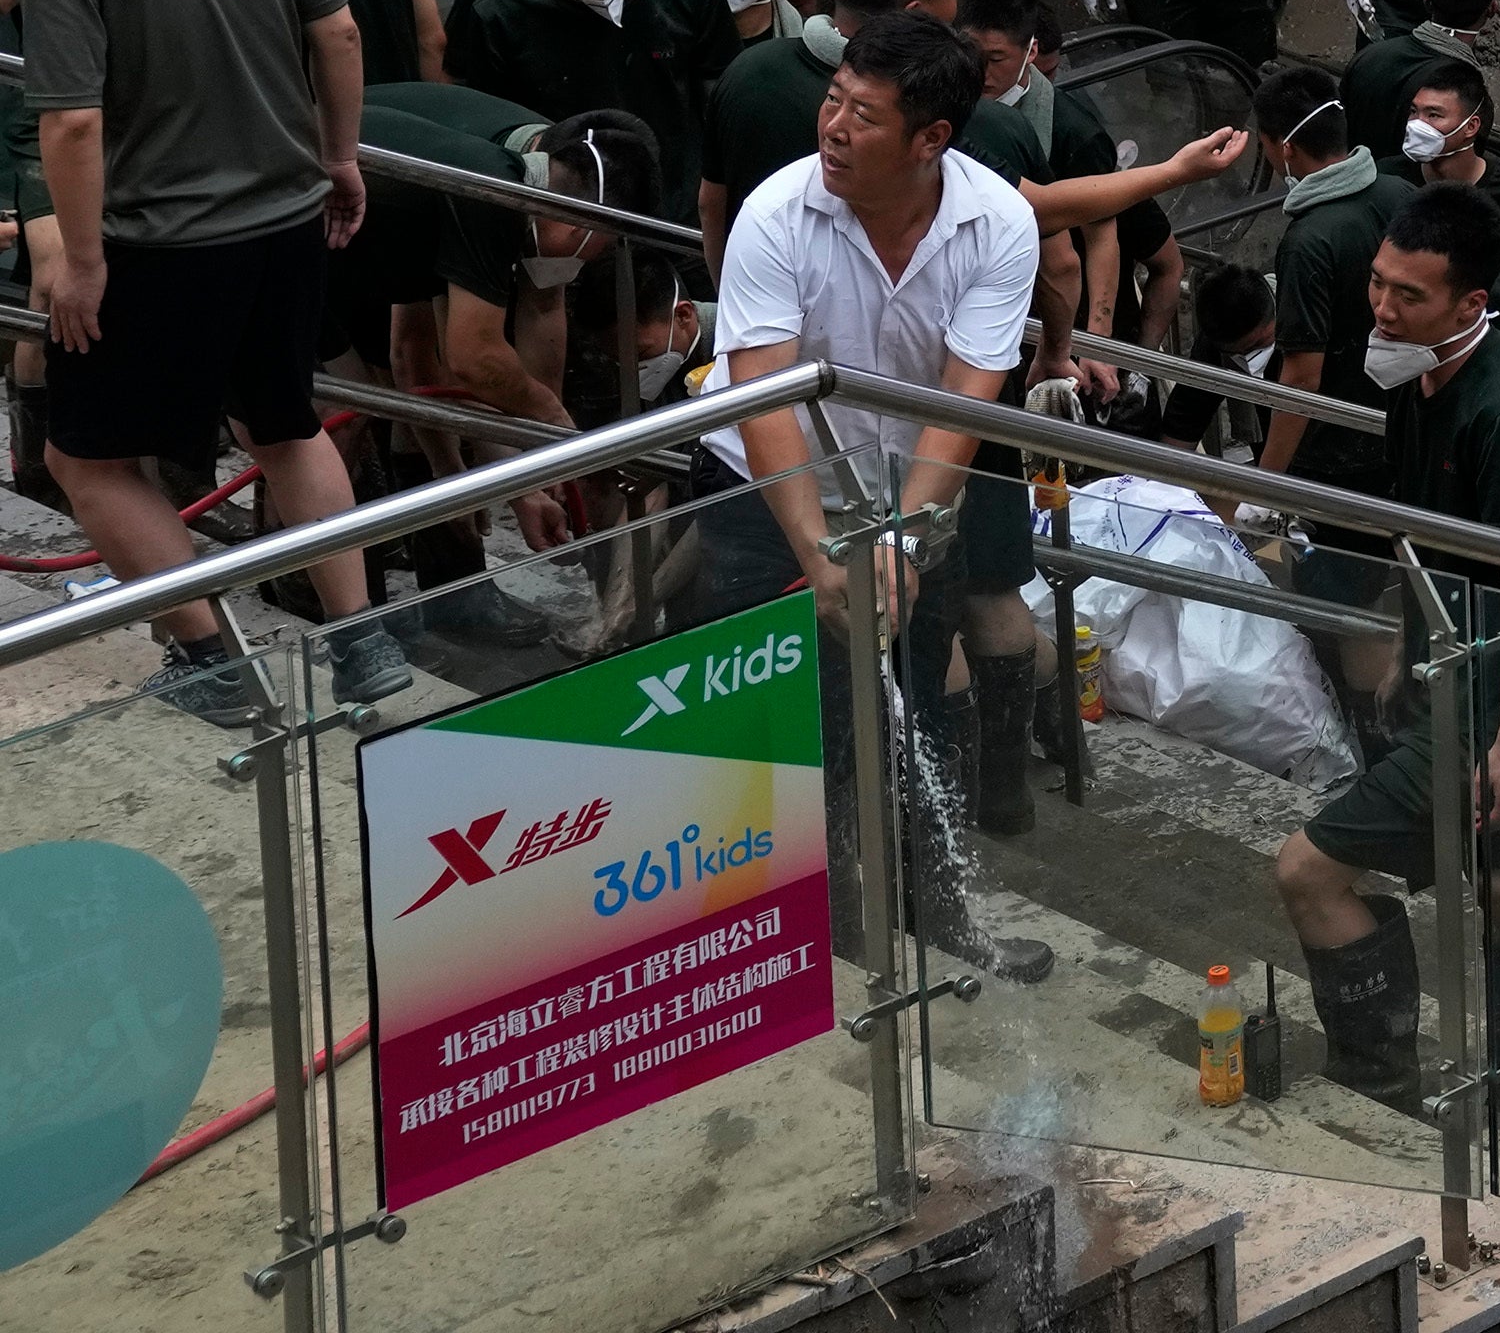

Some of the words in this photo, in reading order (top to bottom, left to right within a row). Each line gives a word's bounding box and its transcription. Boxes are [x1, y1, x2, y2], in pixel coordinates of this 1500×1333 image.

[703, 633, 803, 703] kids
[498, 796, 614, 877] 特步
[695, 824, 775, 883] kids
[399, 941, 817, 1133] 承接各种工程装修设计主体结构施工
[438, 905, 782, 1067] 北京海立睿方工程有限公司
[462, 1073, 597, 1145] 15811119773
[611, 1005, 762, 1083] 18810031600
